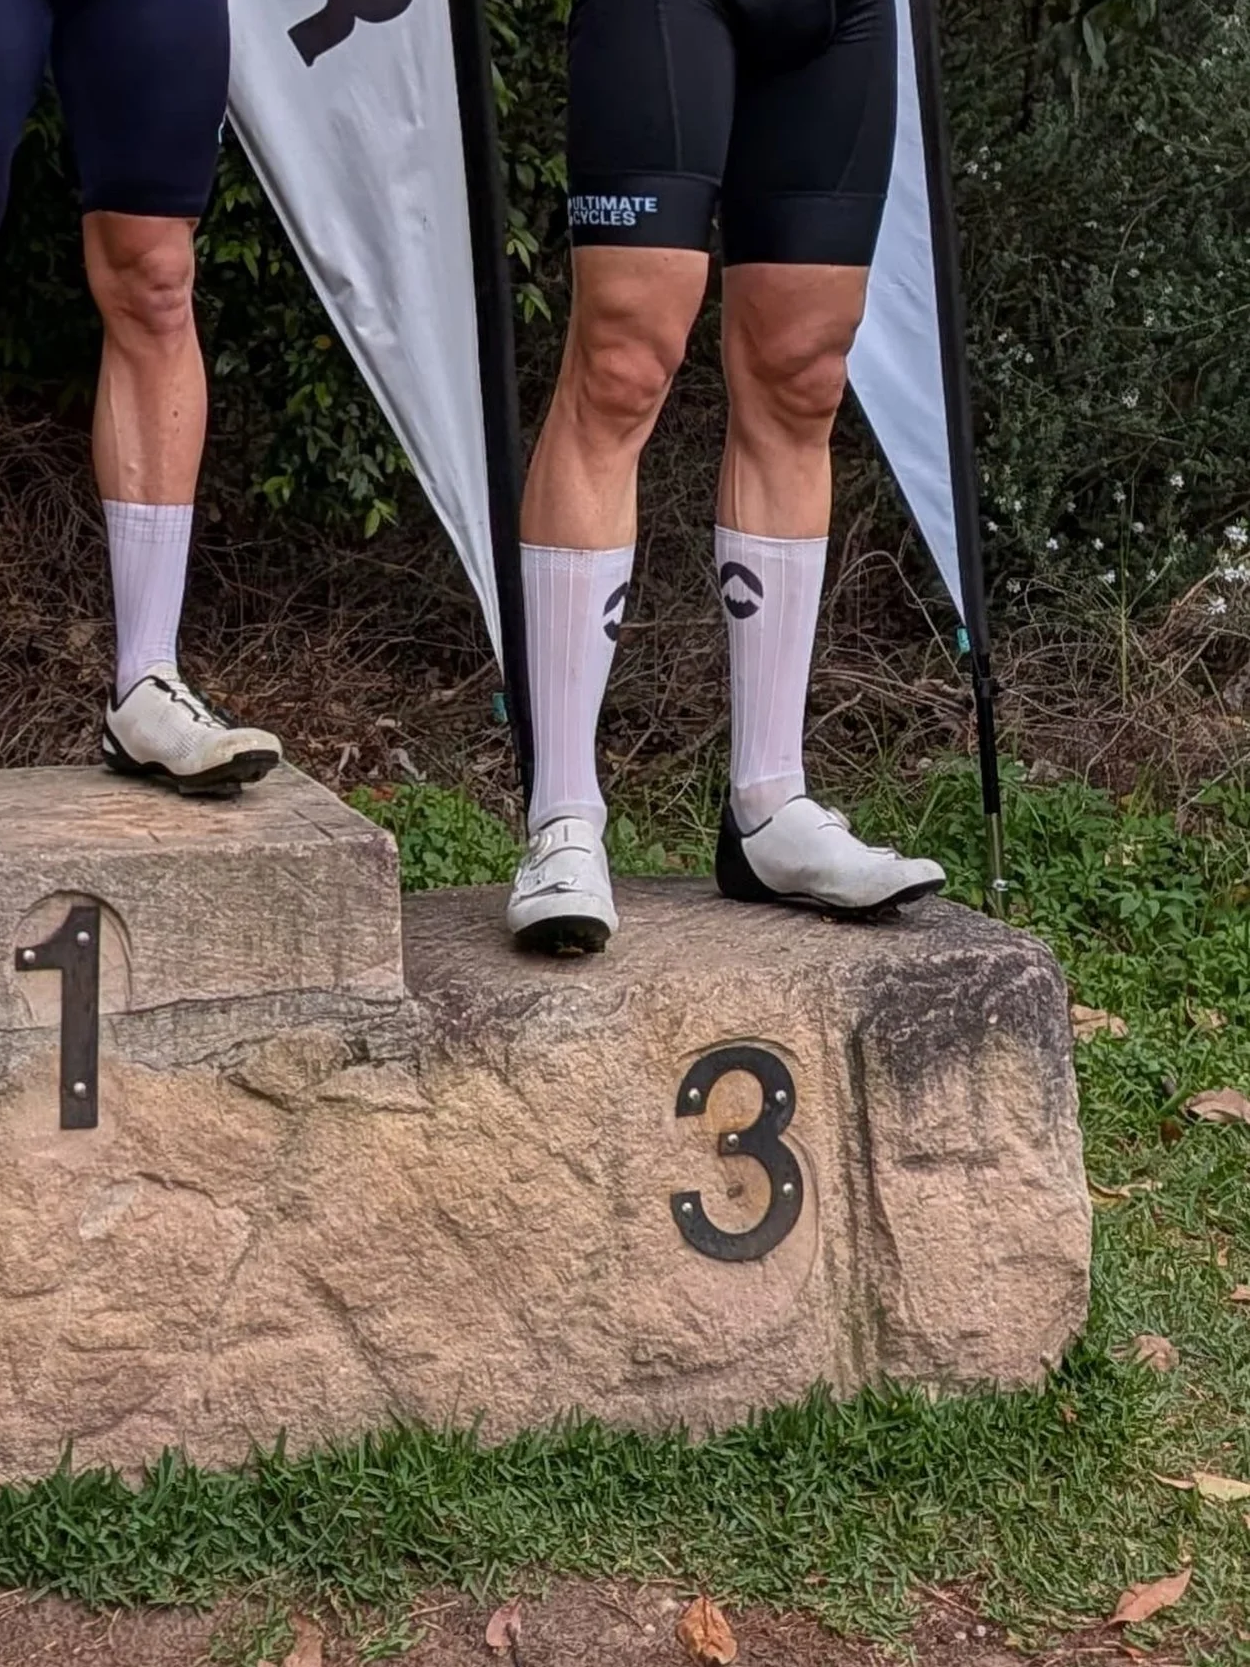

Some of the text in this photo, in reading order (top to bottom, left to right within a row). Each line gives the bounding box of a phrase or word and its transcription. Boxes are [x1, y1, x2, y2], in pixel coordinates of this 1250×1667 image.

[572, 195, 658, 213] ULTIMATE
[573, 209, 637, 226] CYCLES
[15, 906, 100, 1130] 1
[670, 1046, 804, 1263] 3
